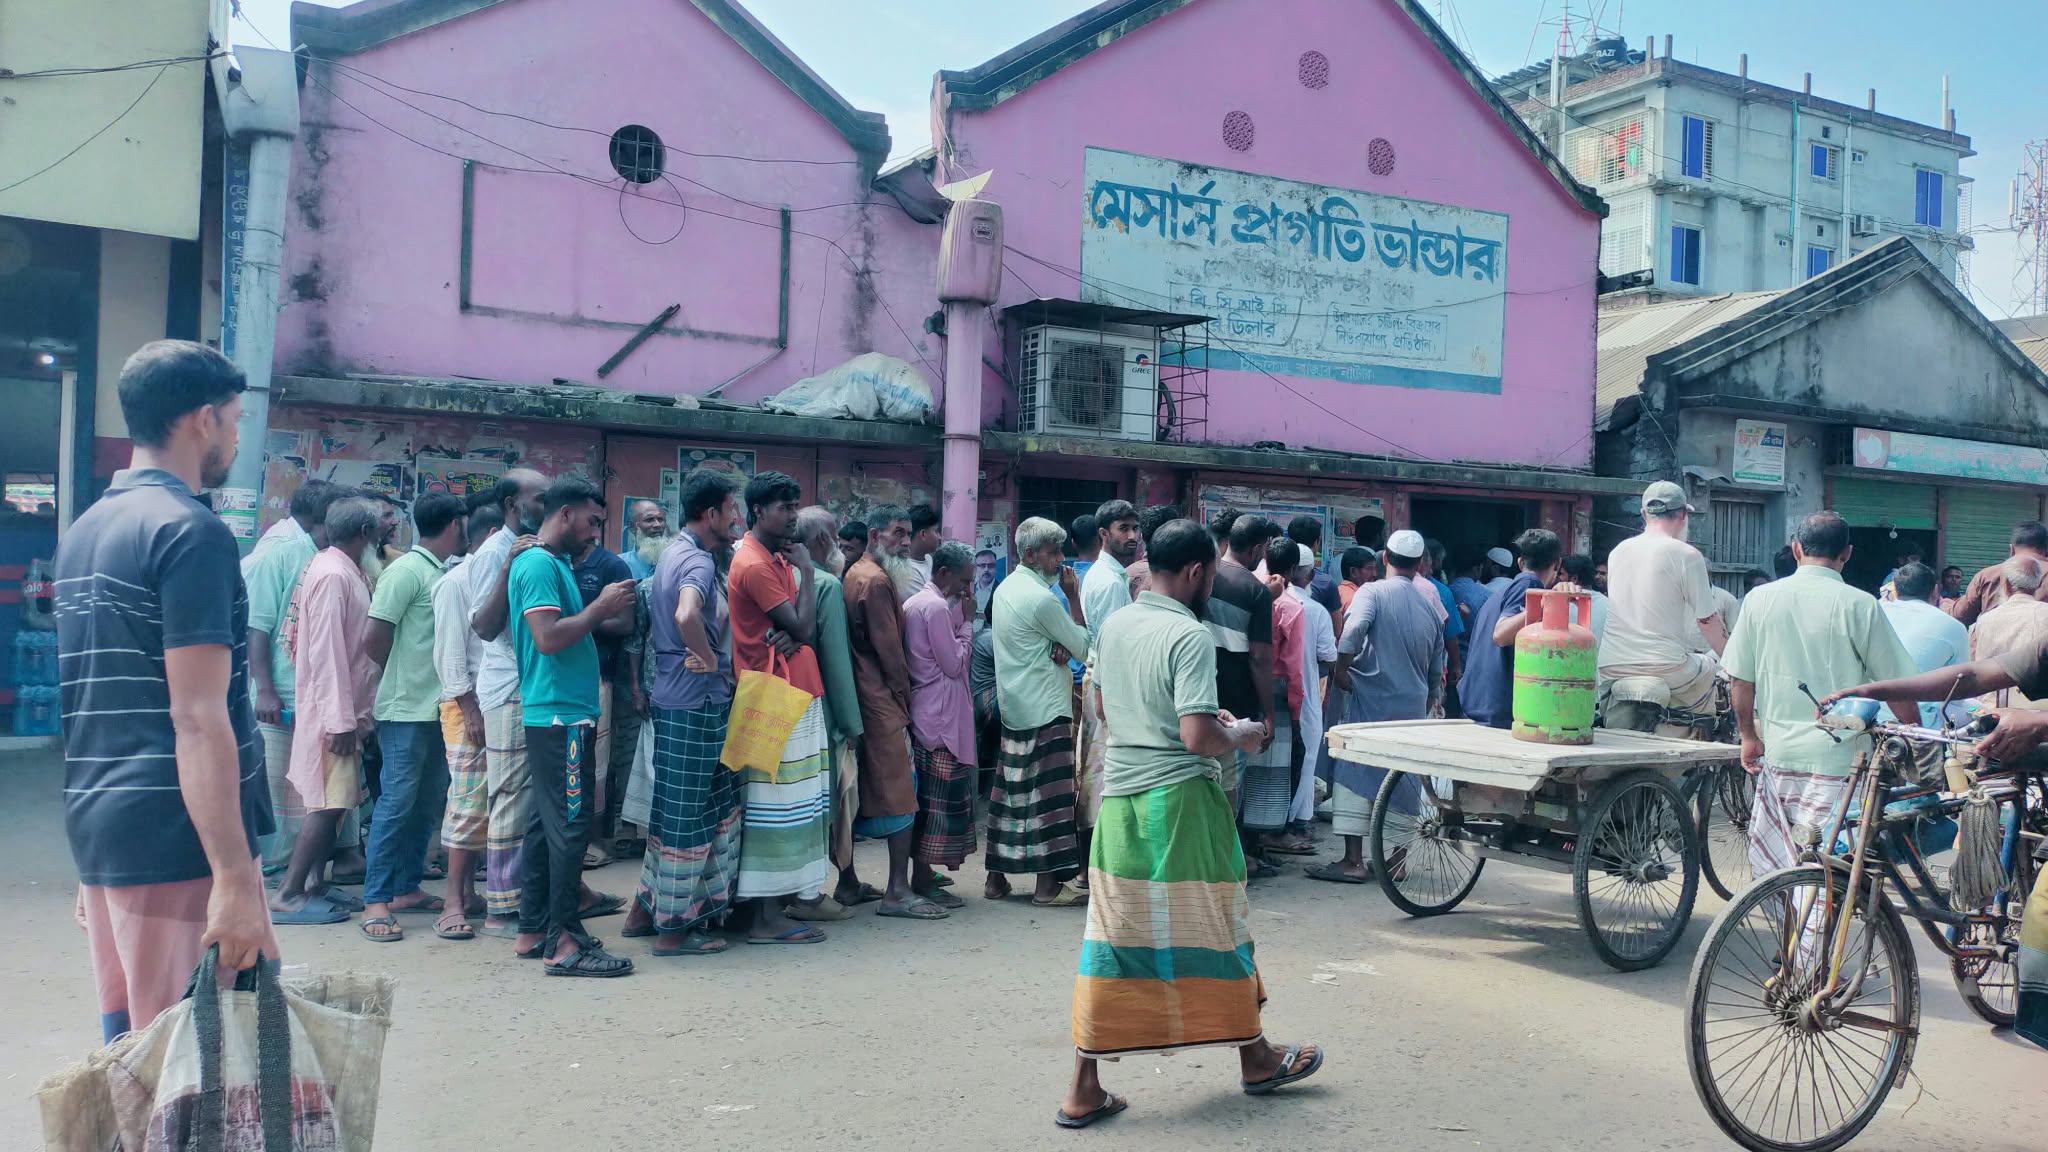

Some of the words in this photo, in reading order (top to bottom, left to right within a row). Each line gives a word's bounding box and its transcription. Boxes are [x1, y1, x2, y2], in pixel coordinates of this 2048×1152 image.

[1091, 180, 1223, 246] মেসার্স
[1231, 196, 1365, 262] প্রগতি
[1371, 218, 1503, 285] ভান্ডার
[1227, 311, 1276, 338] ডিলার
[1131, 367, 1152, 375] GREE
